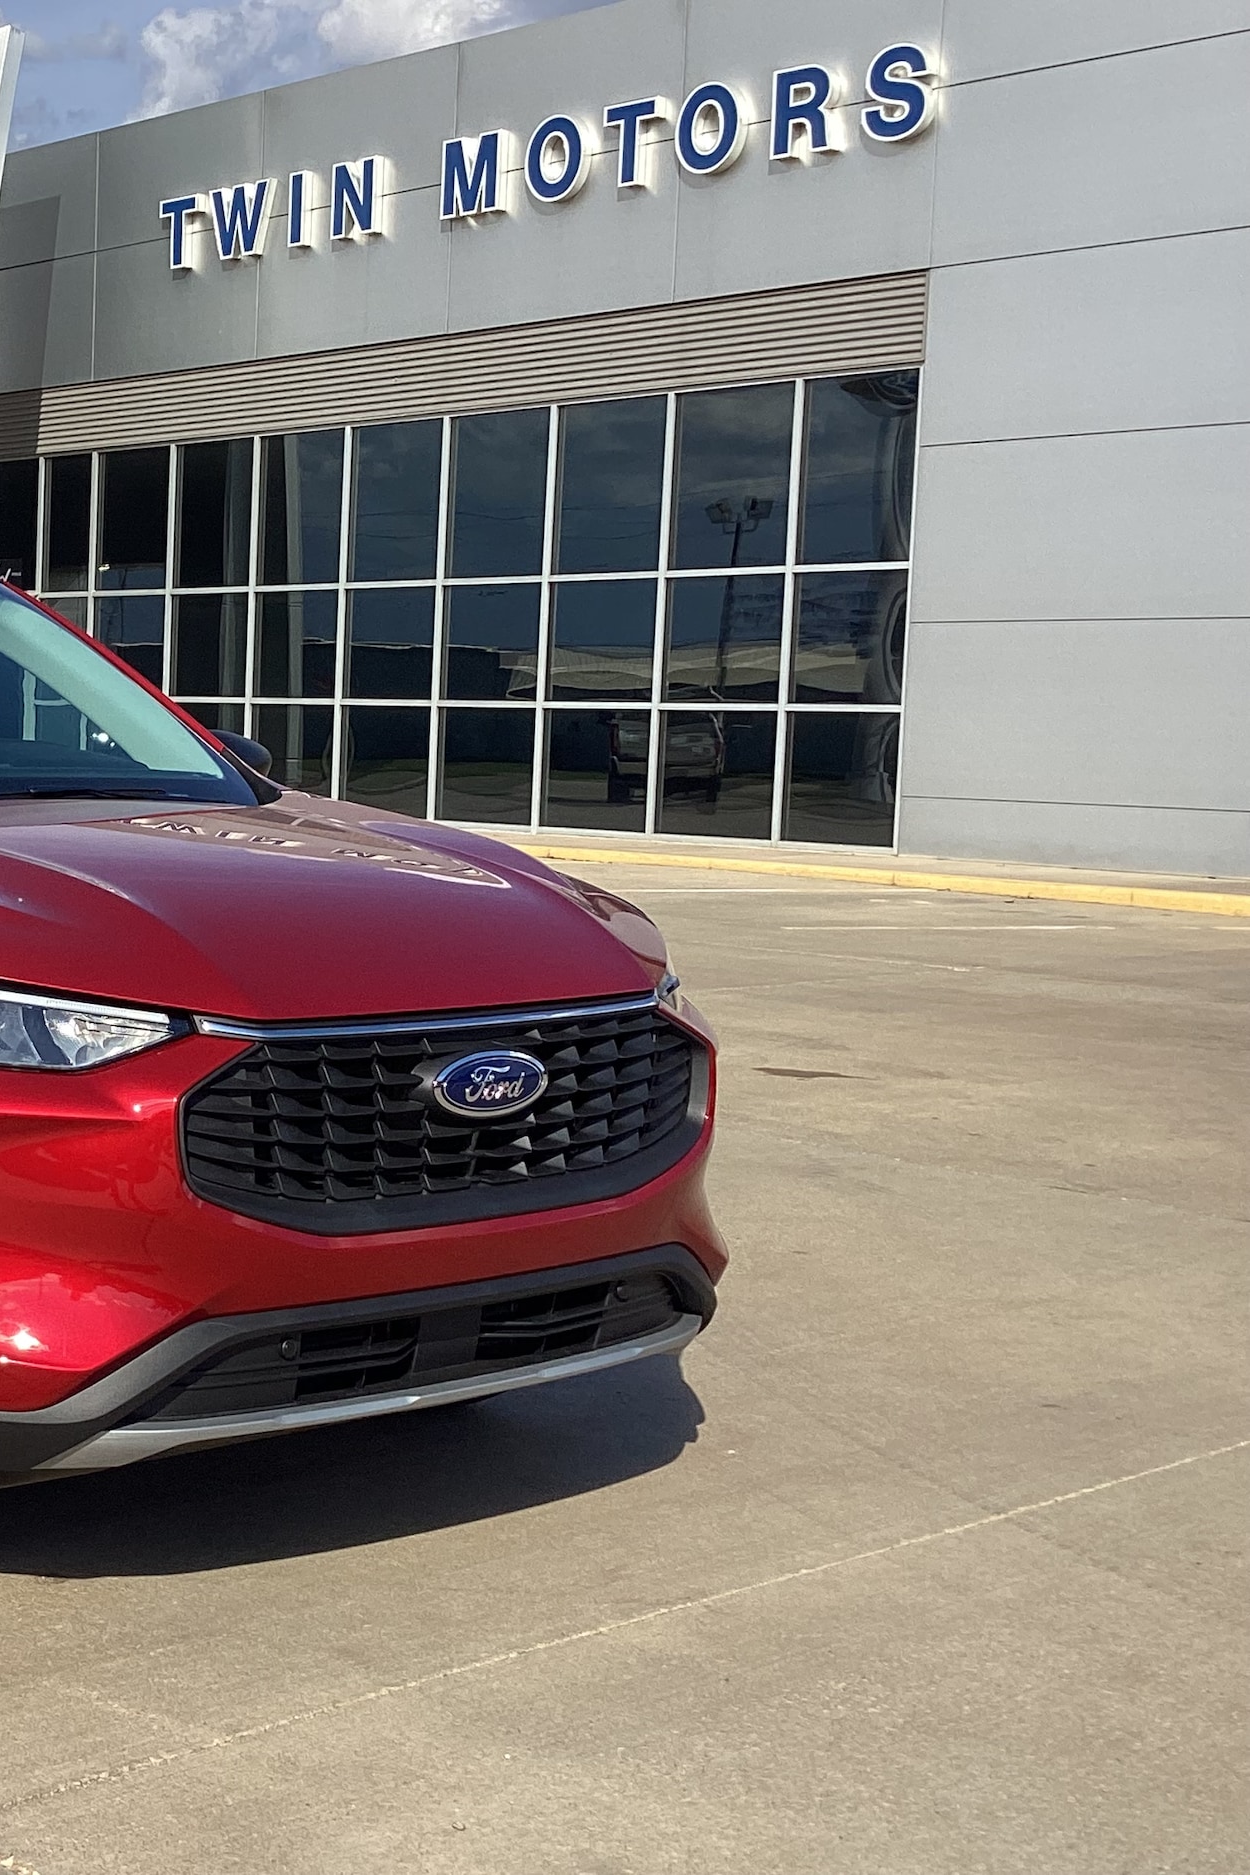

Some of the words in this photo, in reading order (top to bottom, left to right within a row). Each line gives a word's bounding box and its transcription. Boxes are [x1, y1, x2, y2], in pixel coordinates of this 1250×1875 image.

[158, 155, 386, 270] TWIN
[438, 41, 938, 222] MOTORS
[464, 1065, 527, 1103] Ford
